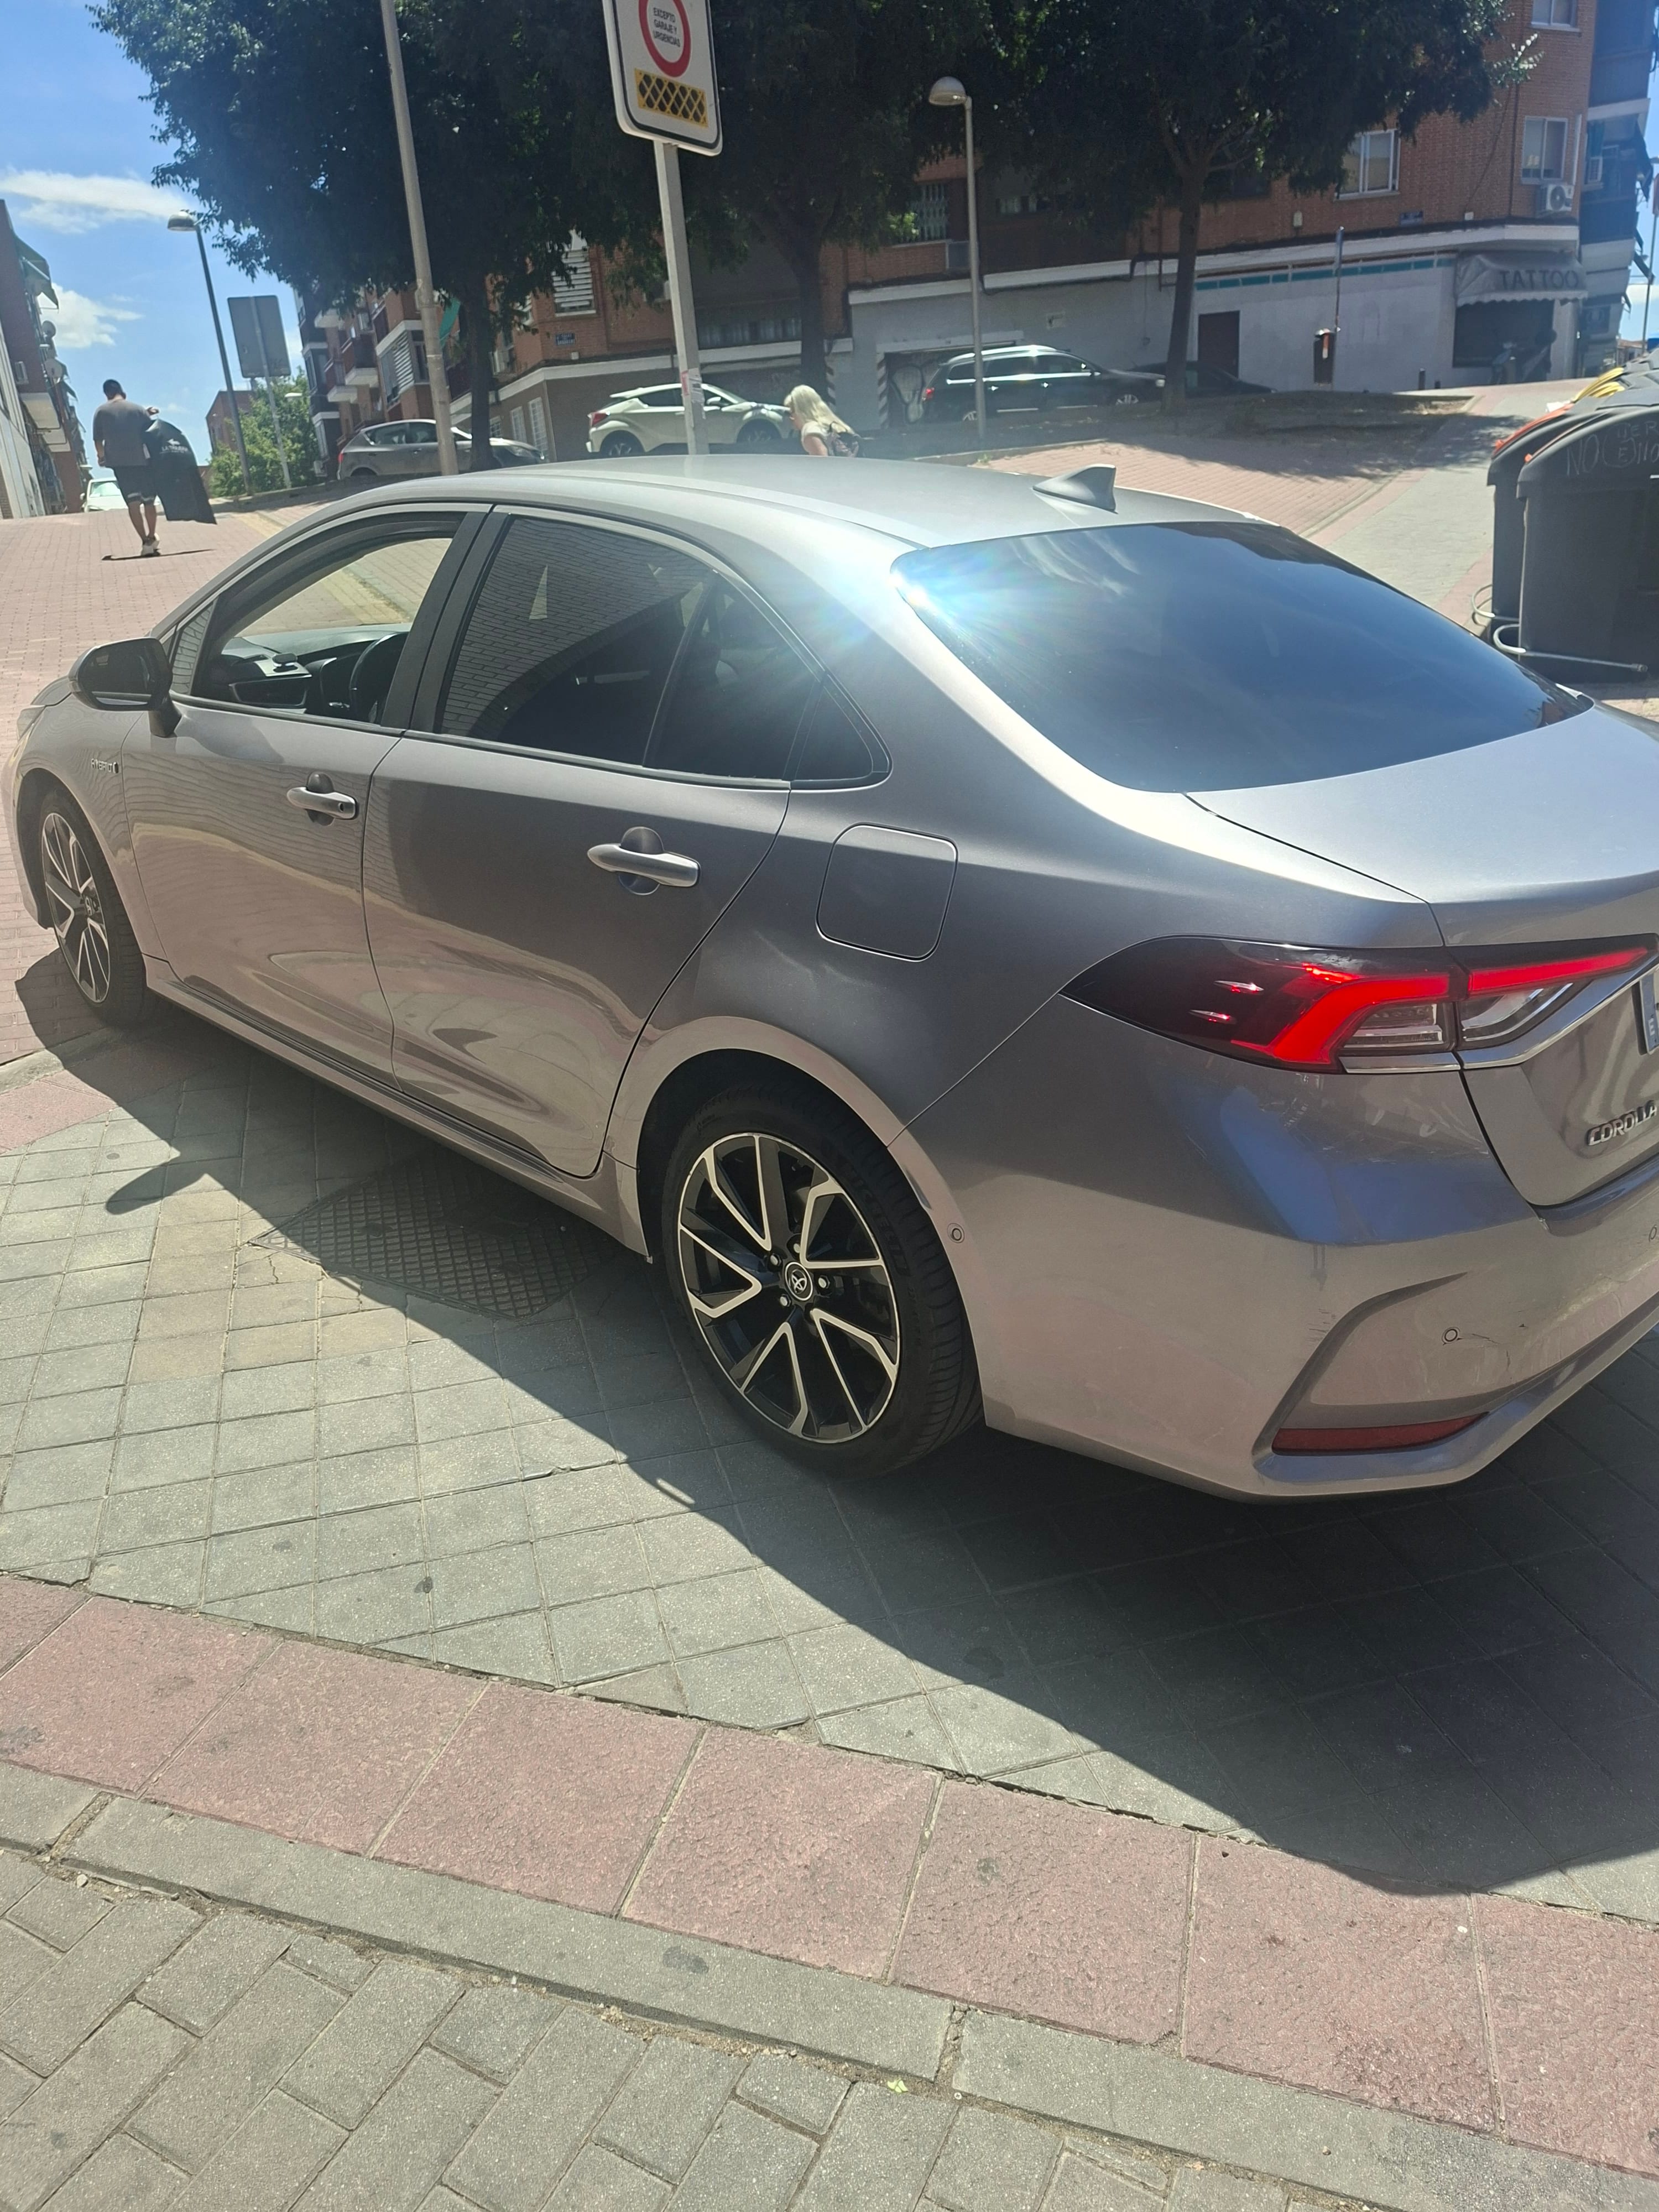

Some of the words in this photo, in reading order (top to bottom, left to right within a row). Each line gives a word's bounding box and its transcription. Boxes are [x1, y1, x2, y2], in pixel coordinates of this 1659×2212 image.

[653, 7, 675, 22] EXCEPTO
[654, 19, 673, 33] GARAJE
[653, 30, 681, 48] URGENCIAS
[1499, 269, 1579, 290] TATTOO
[1588, 1101, 1657, 1146] COROLLA
